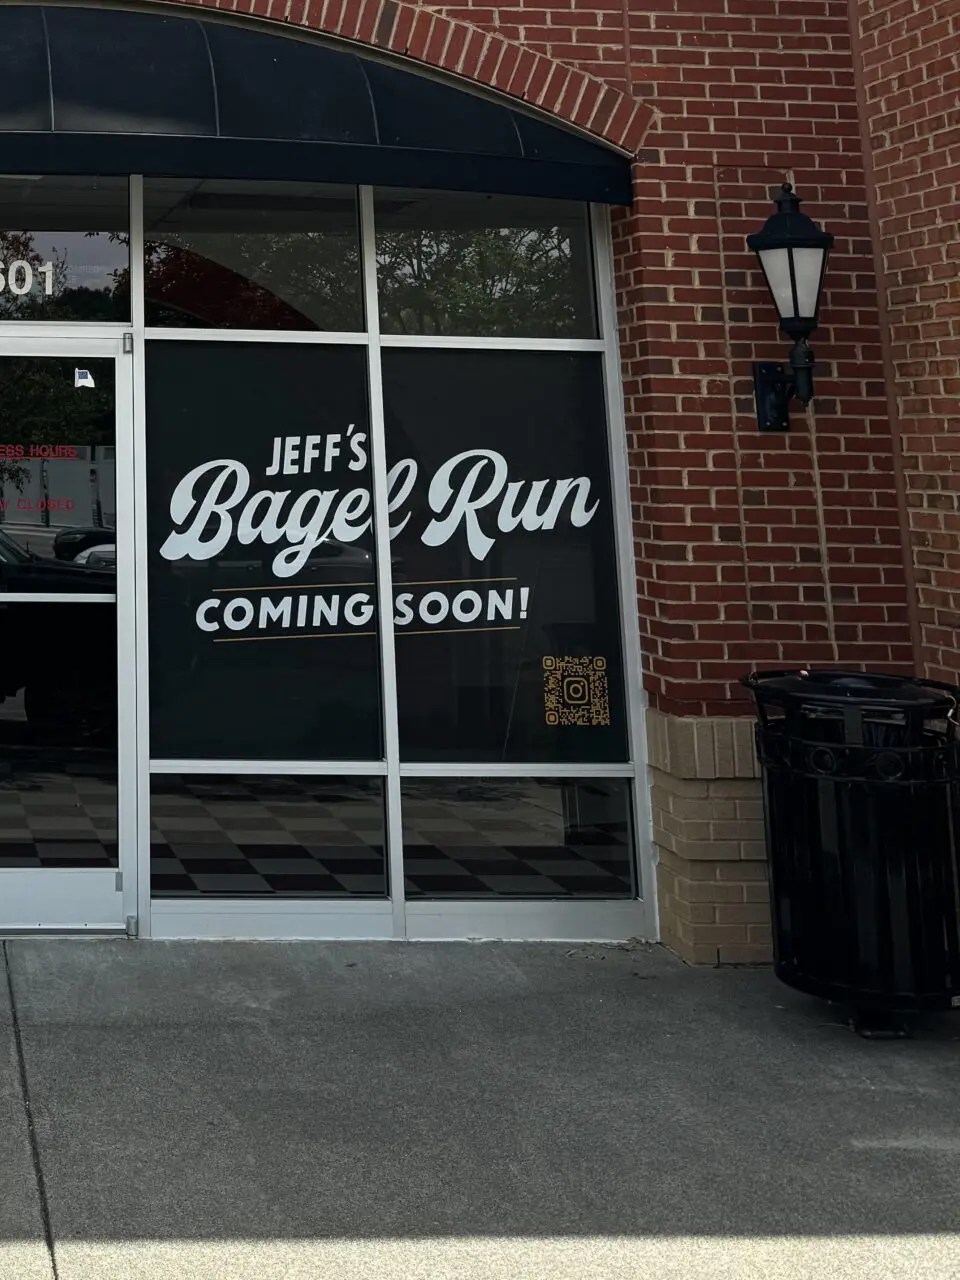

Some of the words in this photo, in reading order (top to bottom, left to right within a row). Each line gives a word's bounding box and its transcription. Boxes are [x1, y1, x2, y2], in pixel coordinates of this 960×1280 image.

[30, 444, 78, 457] HOURS
[265, 423, 368, 476] JEFF'S
[16, 498, 76, 511] CLOSED
[420, 448, 600, 562] Run
[195, 593, 374, 632] COMING
[393, 587, 530, 626] SOON!
